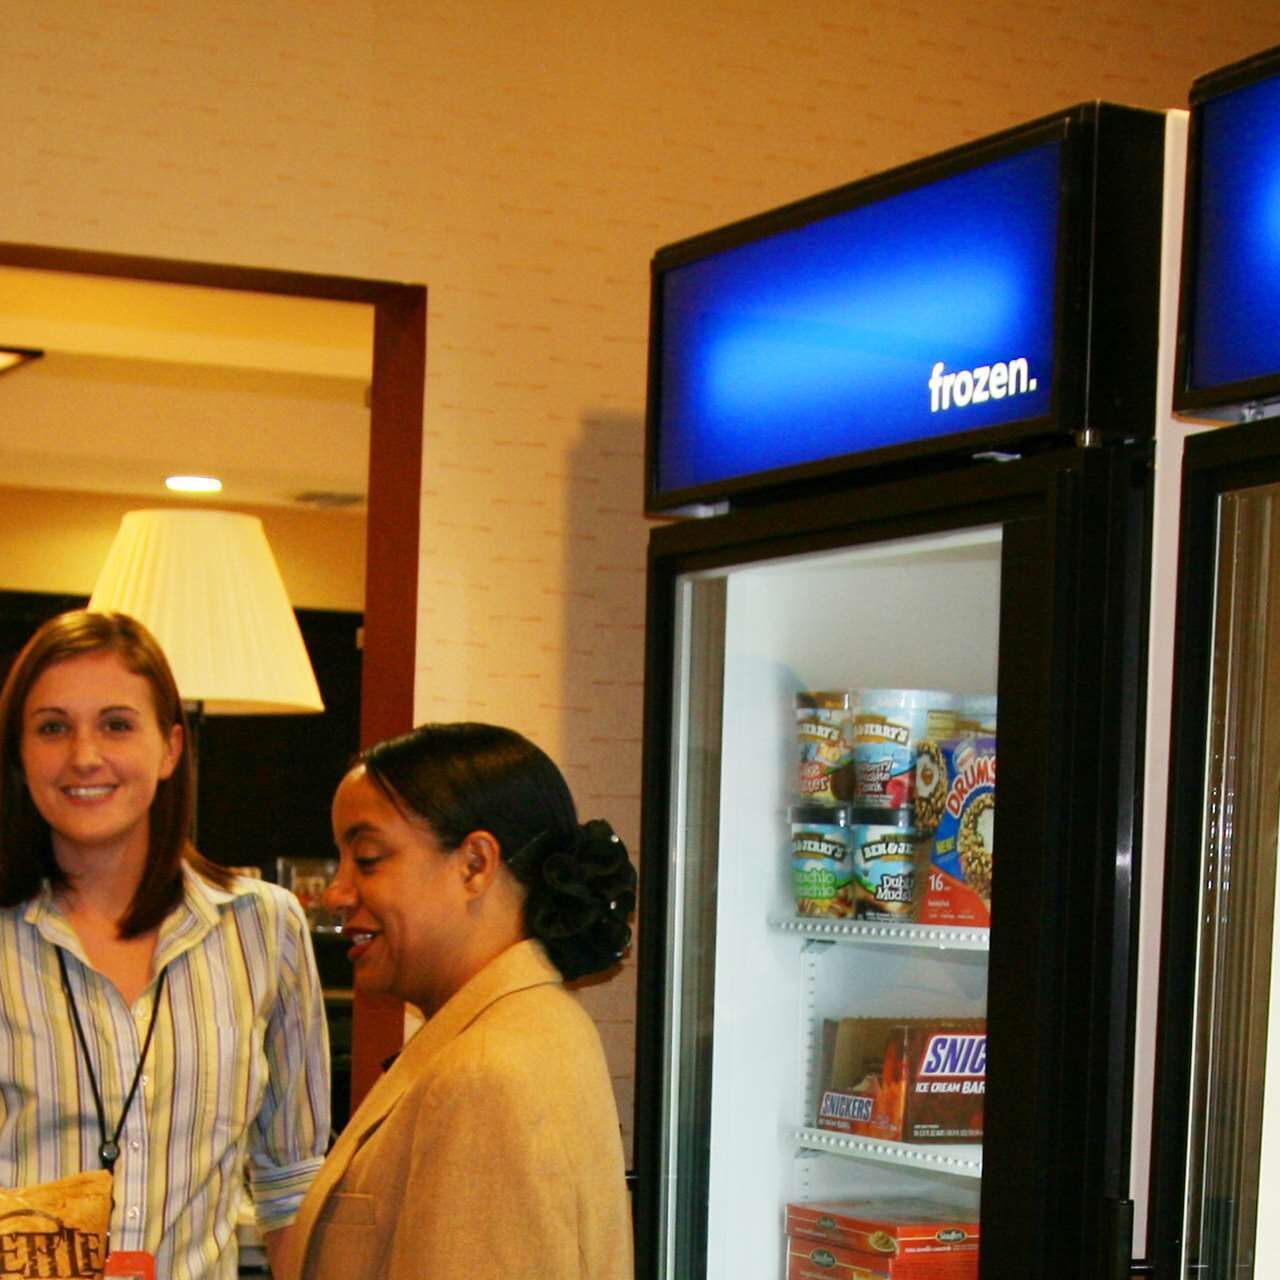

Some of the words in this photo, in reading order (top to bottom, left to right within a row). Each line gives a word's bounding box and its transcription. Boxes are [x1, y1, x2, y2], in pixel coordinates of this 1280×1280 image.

[928, 357, 1037, 412] frozen.
[929, 873, 944, 891] 16
[916, 1082, 929, 1093] ICE
[823, 1094, 871, 1121] SNICKERS
